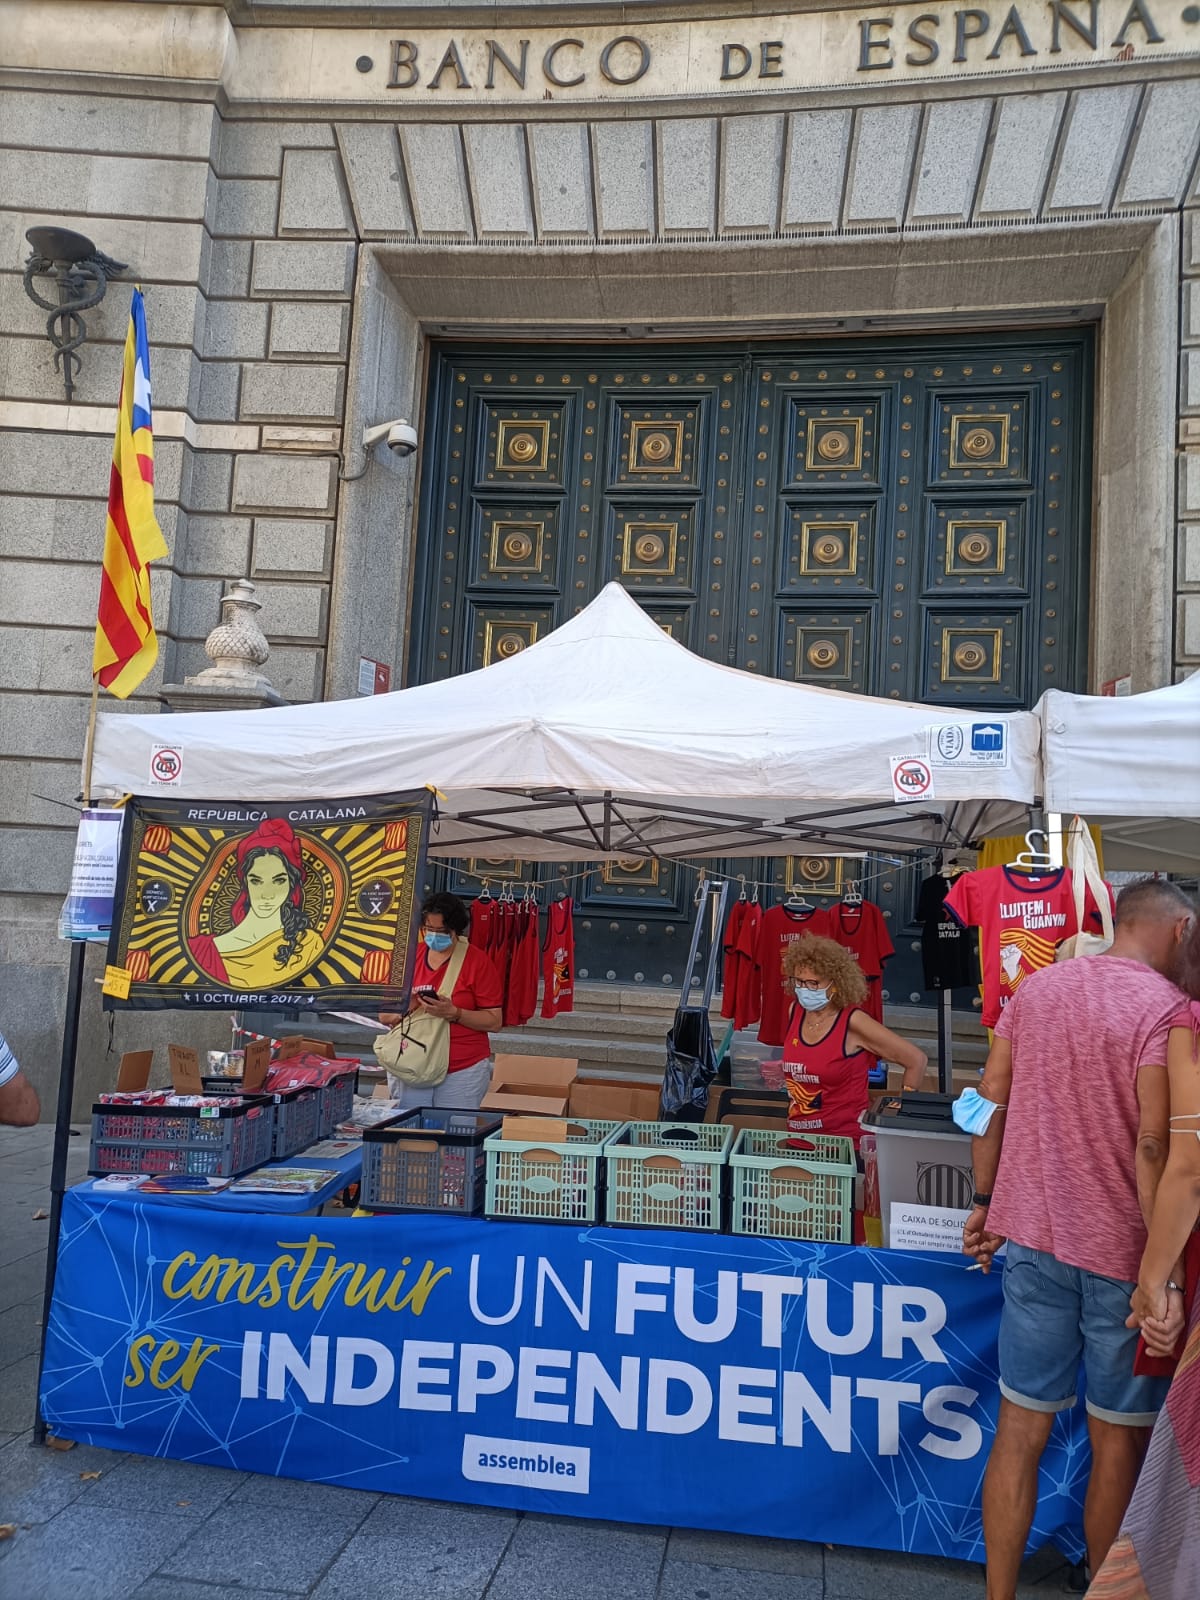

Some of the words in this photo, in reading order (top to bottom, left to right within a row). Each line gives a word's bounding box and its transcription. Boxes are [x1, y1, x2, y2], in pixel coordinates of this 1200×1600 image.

[386, 35, 650, 90] BANCO
[719, 41, 784, 80] DE
[188, 808, 268, 821] REPÚBLICA
[288, 807, 366, 821] CATALANA
[147, 900, 158, 912] X
[370, 901, 382, 914] X
[195, 993, 200, 1003] 1
[203, 993, 267, 1004] OCTUBRE
[270, 995, 301, 1004] 2017
[902, 1214, 927, 1225] CAIXA
[928, 1217, 940, 1226] DE
[162, 1234, 452, 1316] construir
[469, 1254, 592, 1331] UN
[615, 1262, 948, 1364] FUTUR
[124, 1334, 220, 1391] ser
[240, 1330, 983, 1460] INDEPENDENTS
[478, 1453, 576, 1477] assemblea
